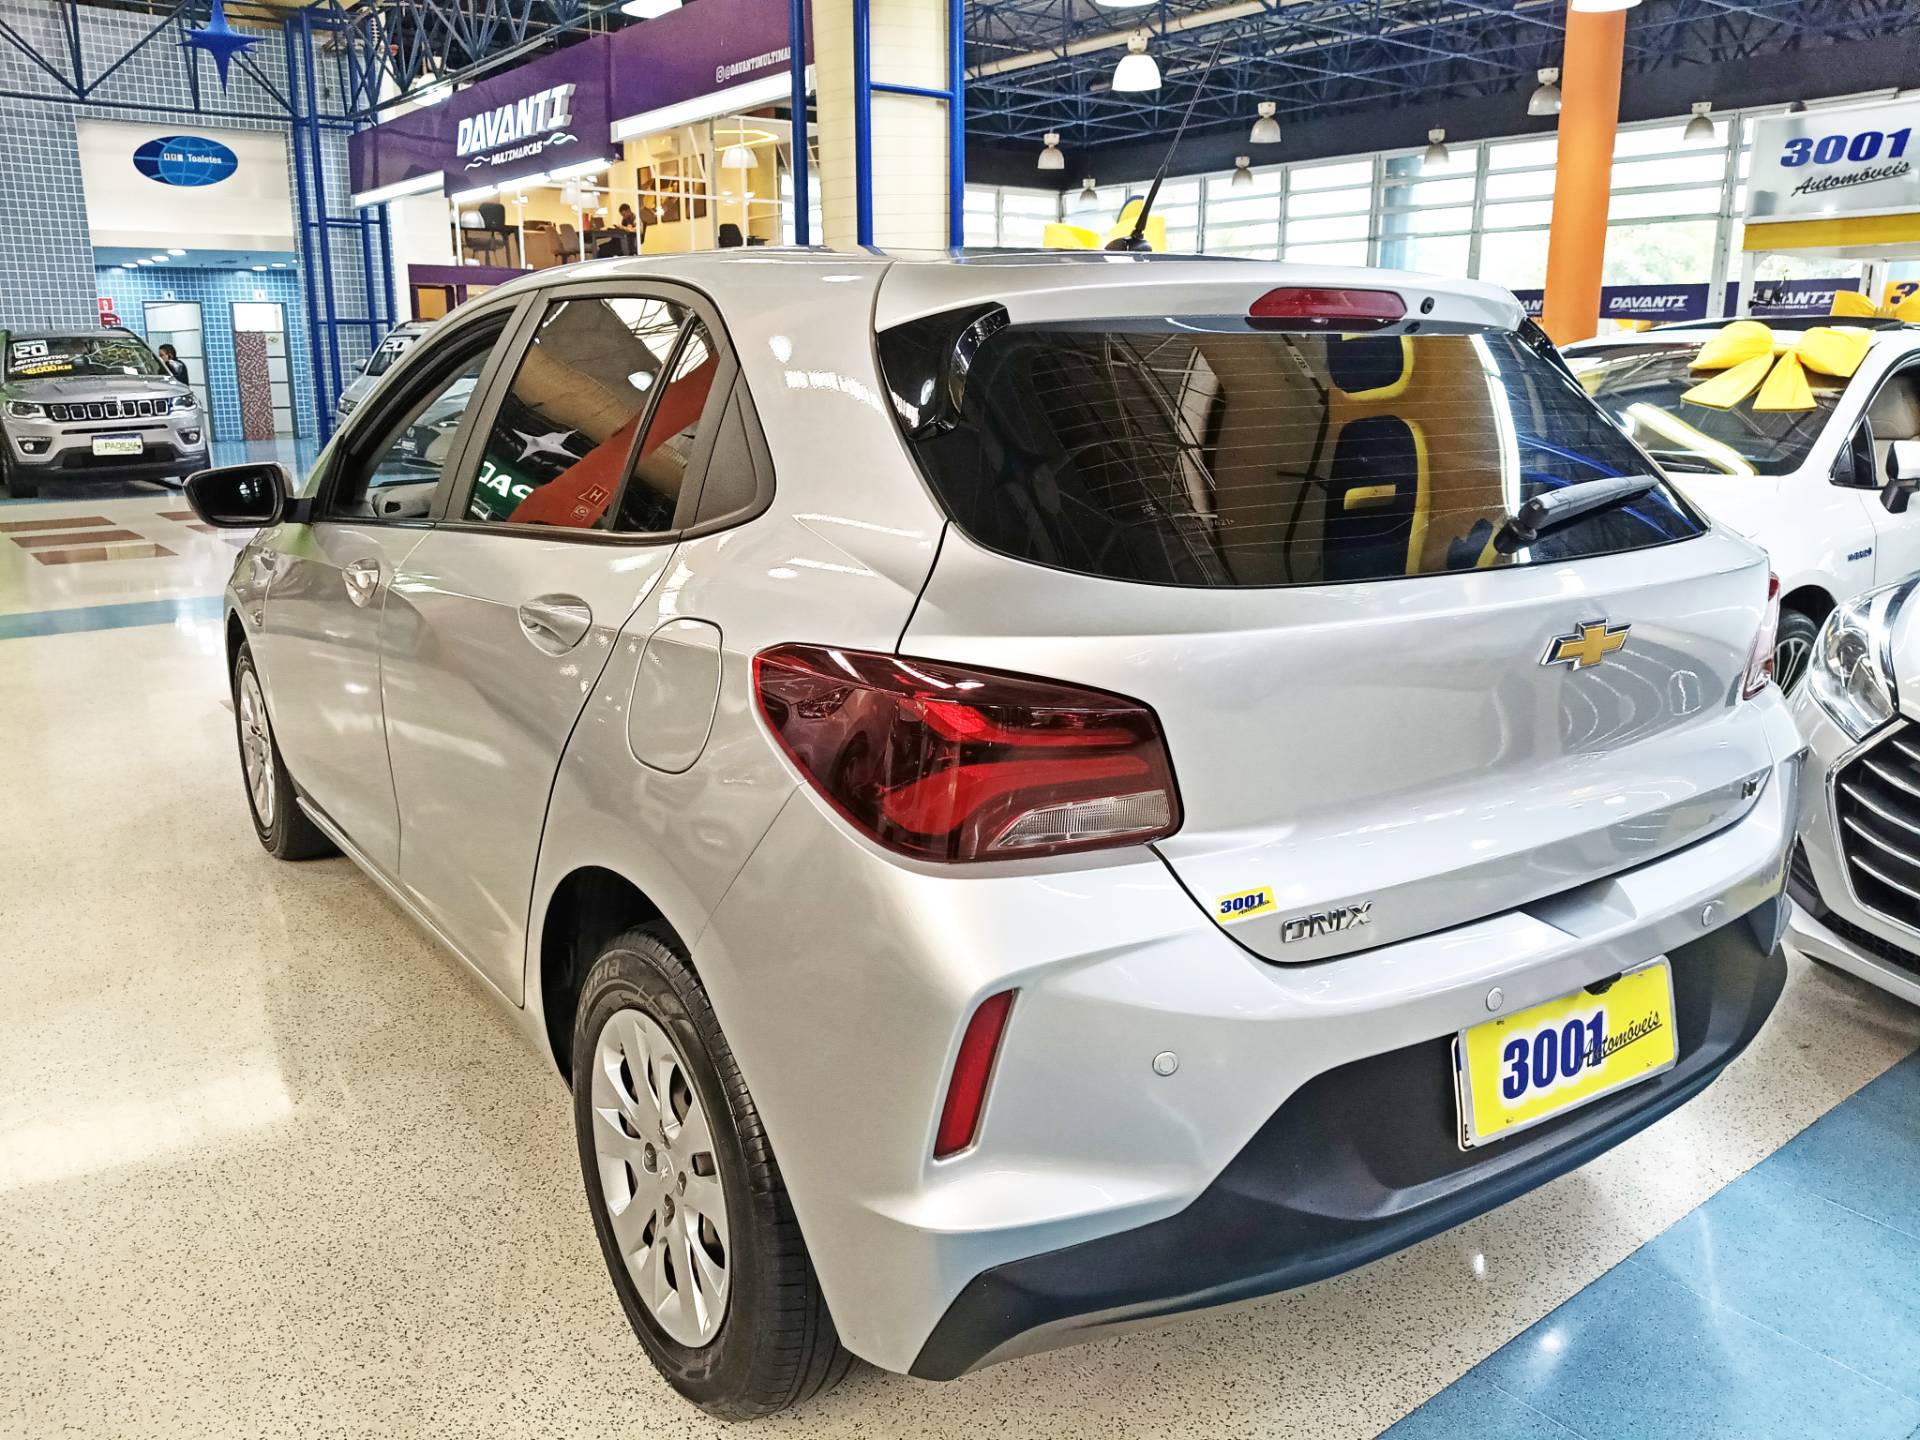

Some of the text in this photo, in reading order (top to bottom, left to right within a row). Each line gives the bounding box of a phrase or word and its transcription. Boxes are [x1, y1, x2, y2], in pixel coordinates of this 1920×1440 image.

[457, 83, 576, 157] DAVANTI
[187, 153, 222, 164] Toaletes
[491, 141, 543, 166] MULTIMARCAS
[1780, 127, 1912, 168] 3001
[1791, 161, 1912, 197] Automóveis
[1609, 295, 1689, 309] DAVANTI
[1220, 892, 1264, 914] 3001
[1281, 900, 1374, 944] ONIX
[1502, 1010, 1604, 1100] 3001
